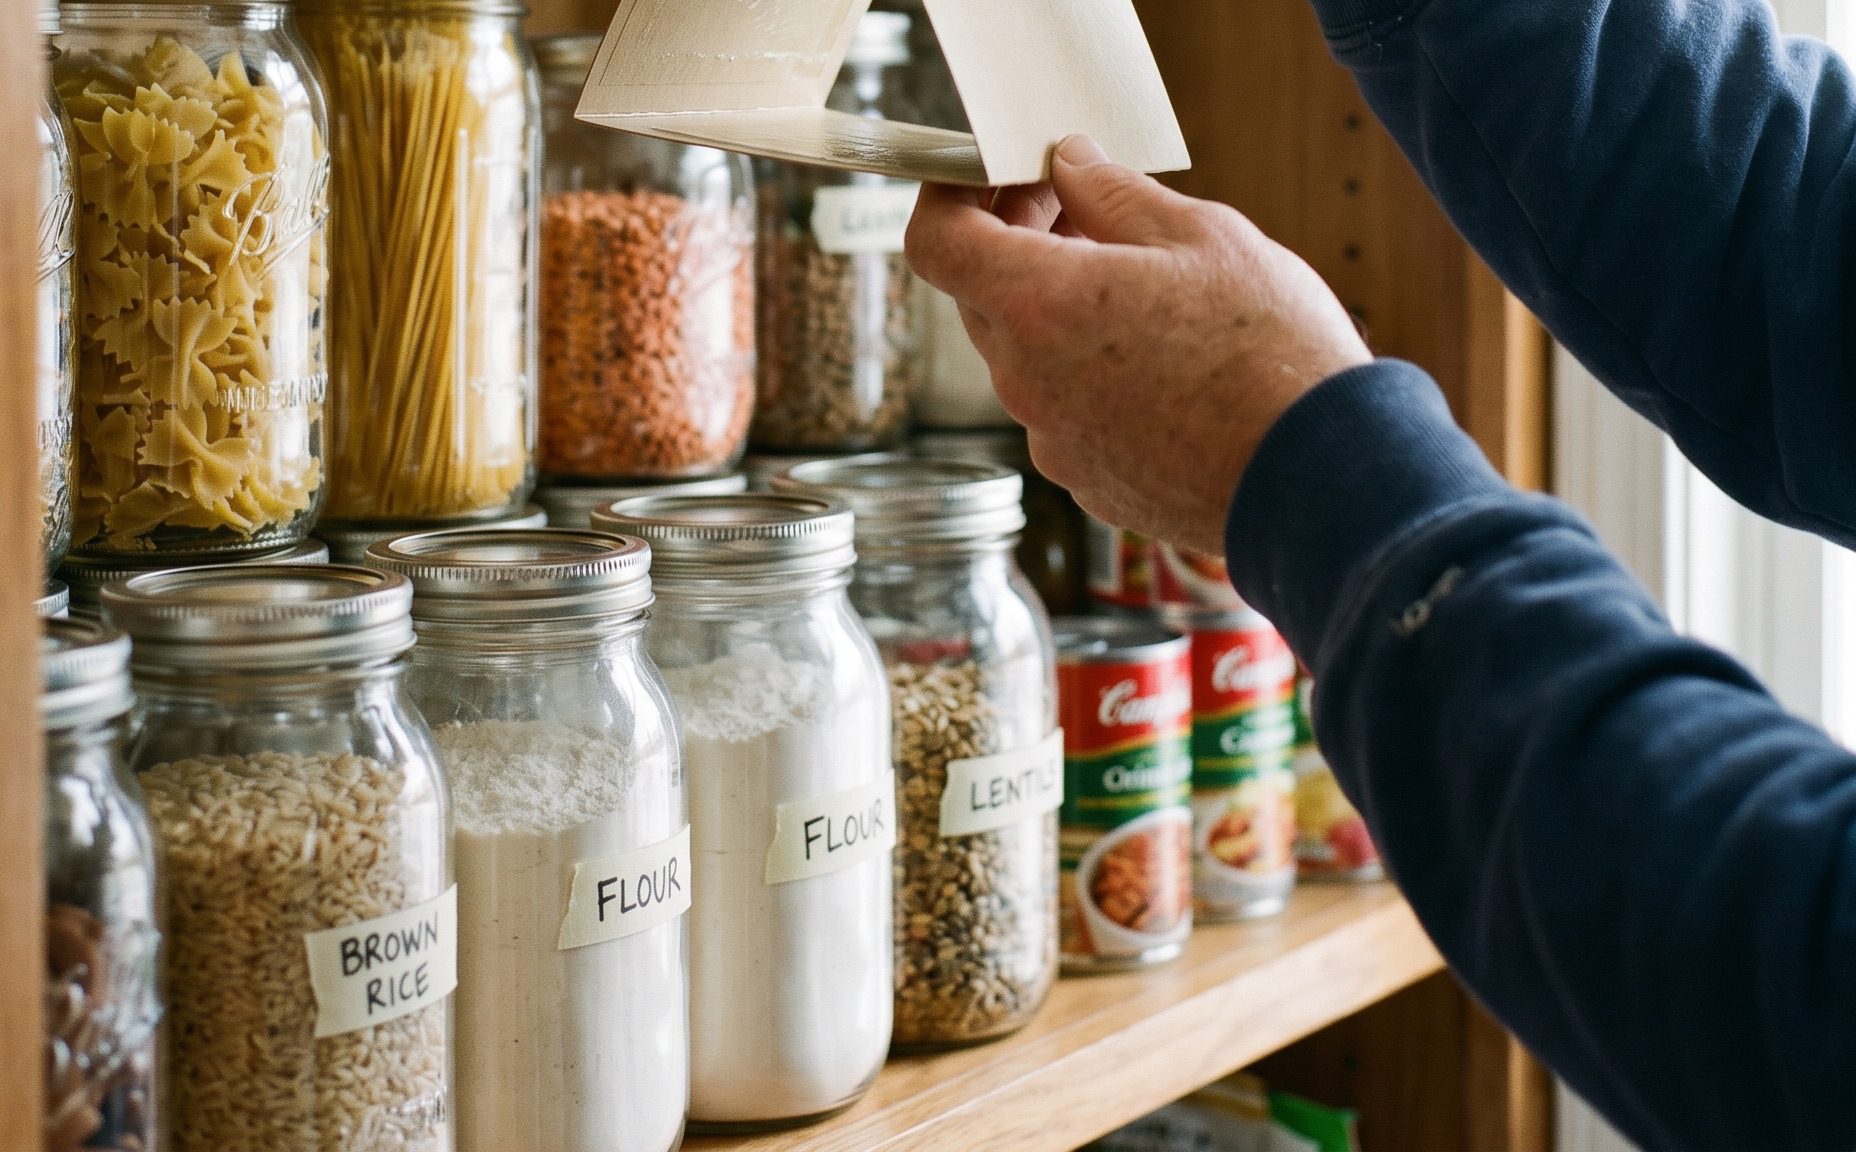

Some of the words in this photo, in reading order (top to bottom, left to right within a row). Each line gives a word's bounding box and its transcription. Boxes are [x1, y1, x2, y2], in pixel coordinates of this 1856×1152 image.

[803, 798, 884, 861] FLOUR
[597, 856, 681, 923] FLOUR
[340, 909, 438, 977] BROWN
[366, 960, 430, 1016] RICE
